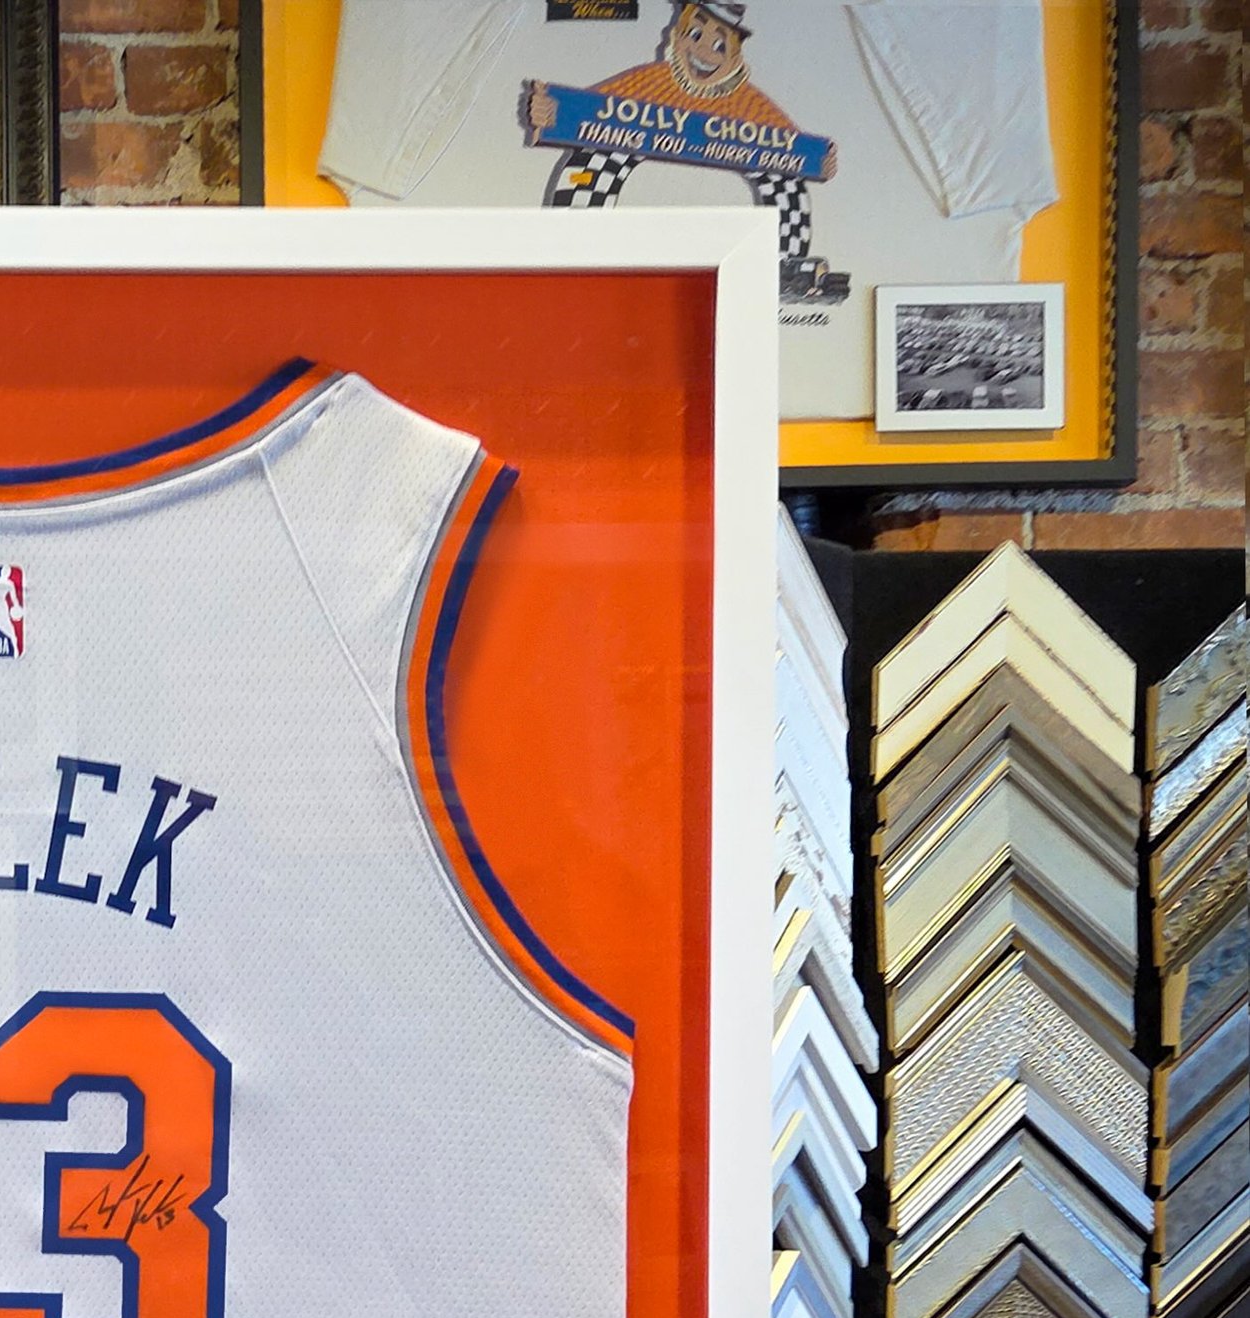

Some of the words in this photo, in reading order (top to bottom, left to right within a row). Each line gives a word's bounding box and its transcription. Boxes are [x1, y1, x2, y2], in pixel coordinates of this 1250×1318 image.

[578, 121, 647, 150] THANKS
[652, 133, 687, 155] YOU
[758, 151, 806, 173] BACK!
[597, 96, 692, 134] JOLLY
[704, 116, 798, 152] CHOLLY
